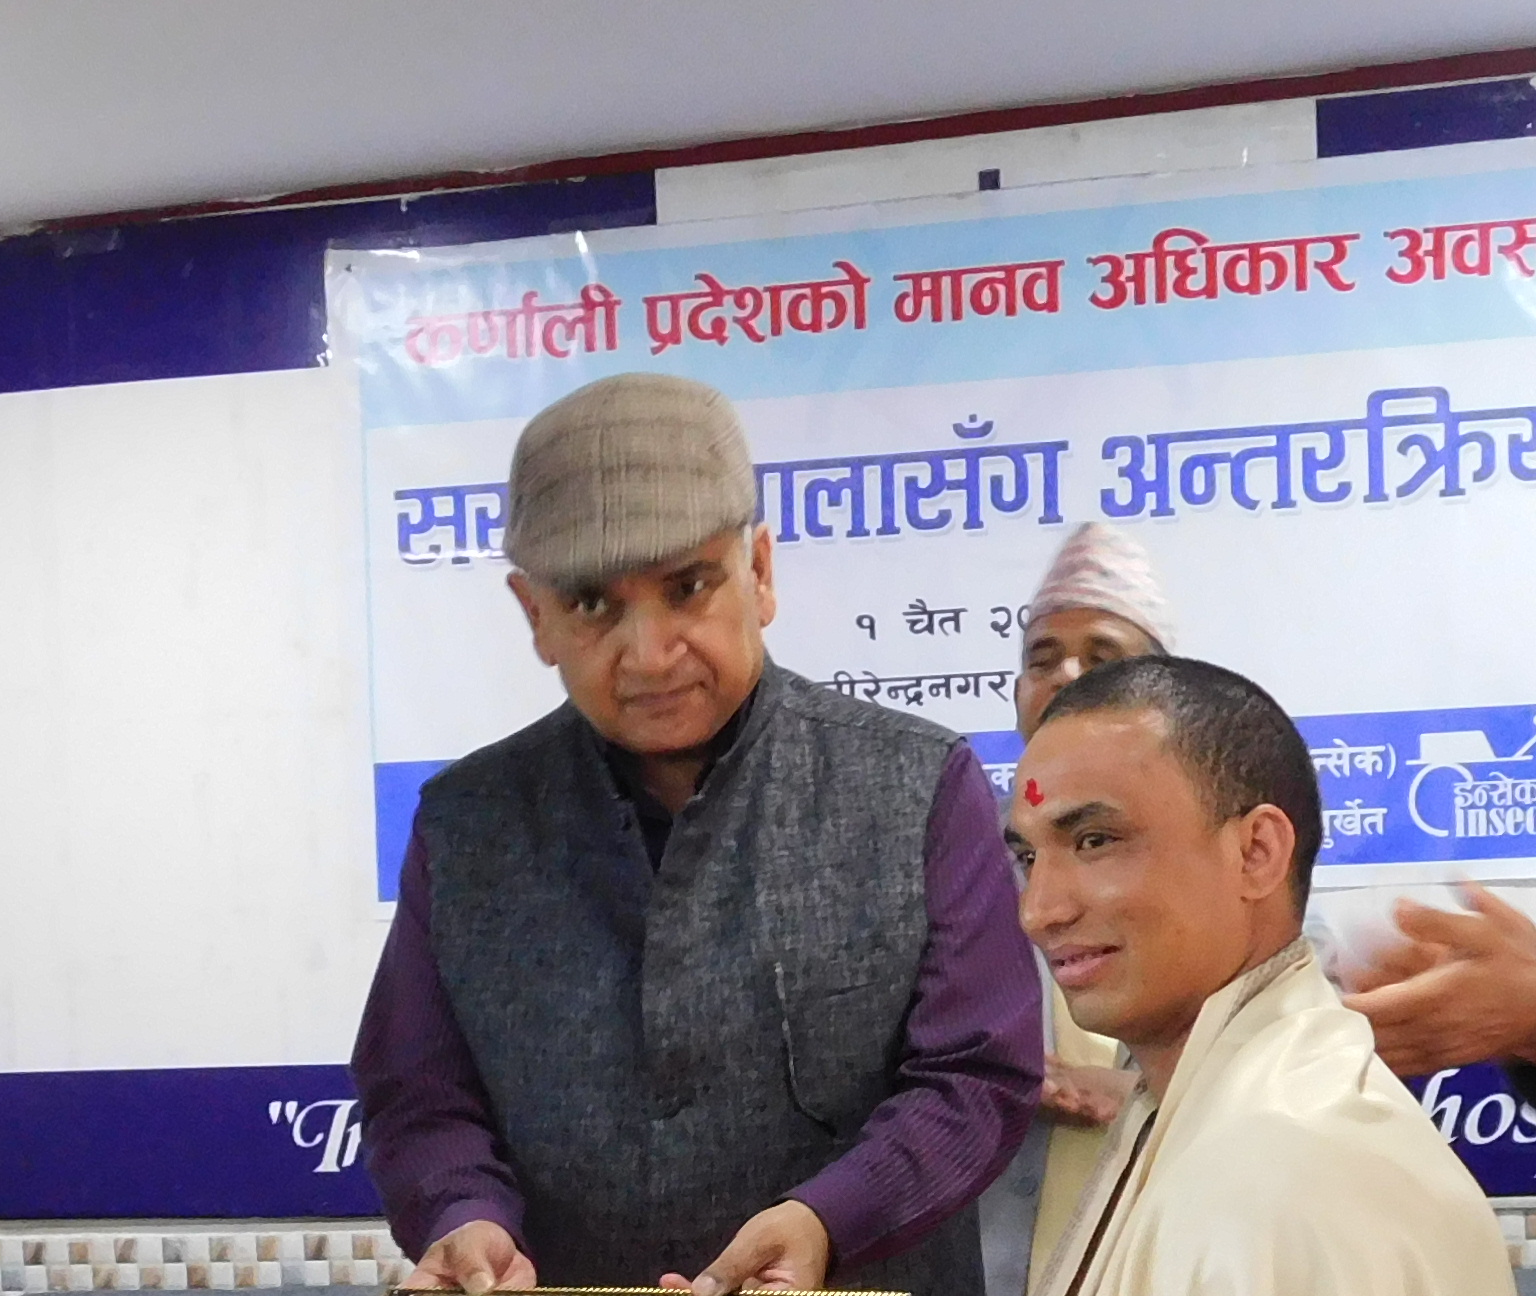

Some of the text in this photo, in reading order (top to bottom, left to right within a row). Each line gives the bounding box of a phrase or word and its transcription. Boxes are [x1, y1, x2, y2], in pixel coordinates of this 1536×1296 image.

[404, 281, 621, 364] कर्णाली
[642, 259, 871, 356] प्रदेशको
[892, 256, 1064, 323] मानव
[1086, 226, 1361, 312] अधिकार
[855, 613, 877, 640] १
[902, 598, 968, 637] चैत
[814, 670, 1014, 706] ीरेन्द्रनगर
